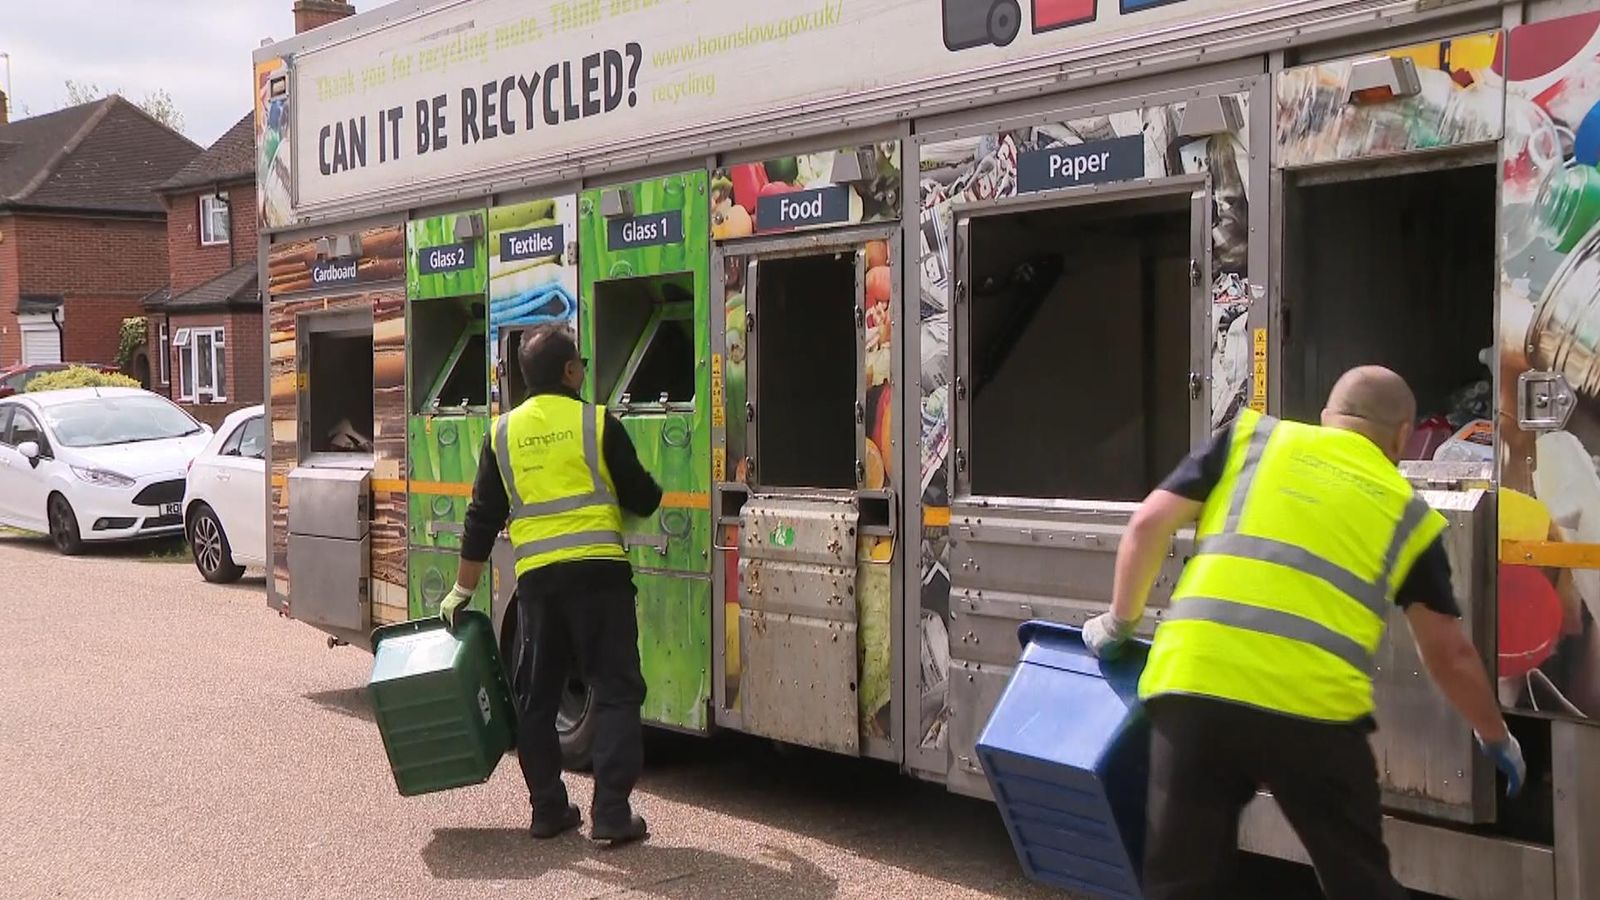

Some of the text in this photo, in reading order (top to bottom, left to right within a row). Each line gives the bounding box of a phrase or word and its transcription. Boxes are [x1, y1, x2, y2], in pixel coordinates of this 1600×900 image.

[361, 66, 386, 95] you
[392, 54, 413, 79] for
[419, 31, 489, 72] recycling
[652, 72, 716, 103] recycling
[319, 42, 642, 175] CAN IT BE RECYCLED?
[1049, 151, 1110, 179] Paper
[780, 188, 823, 221] Food
[622, 218, 668, 243] Glass 1
[429, 248, 465, 268] Glass 2
[509, 235, 553, 256] Textiles
[313, 261, 356, 283] Cardboard
[517, 430, 574, 448] Lampton
